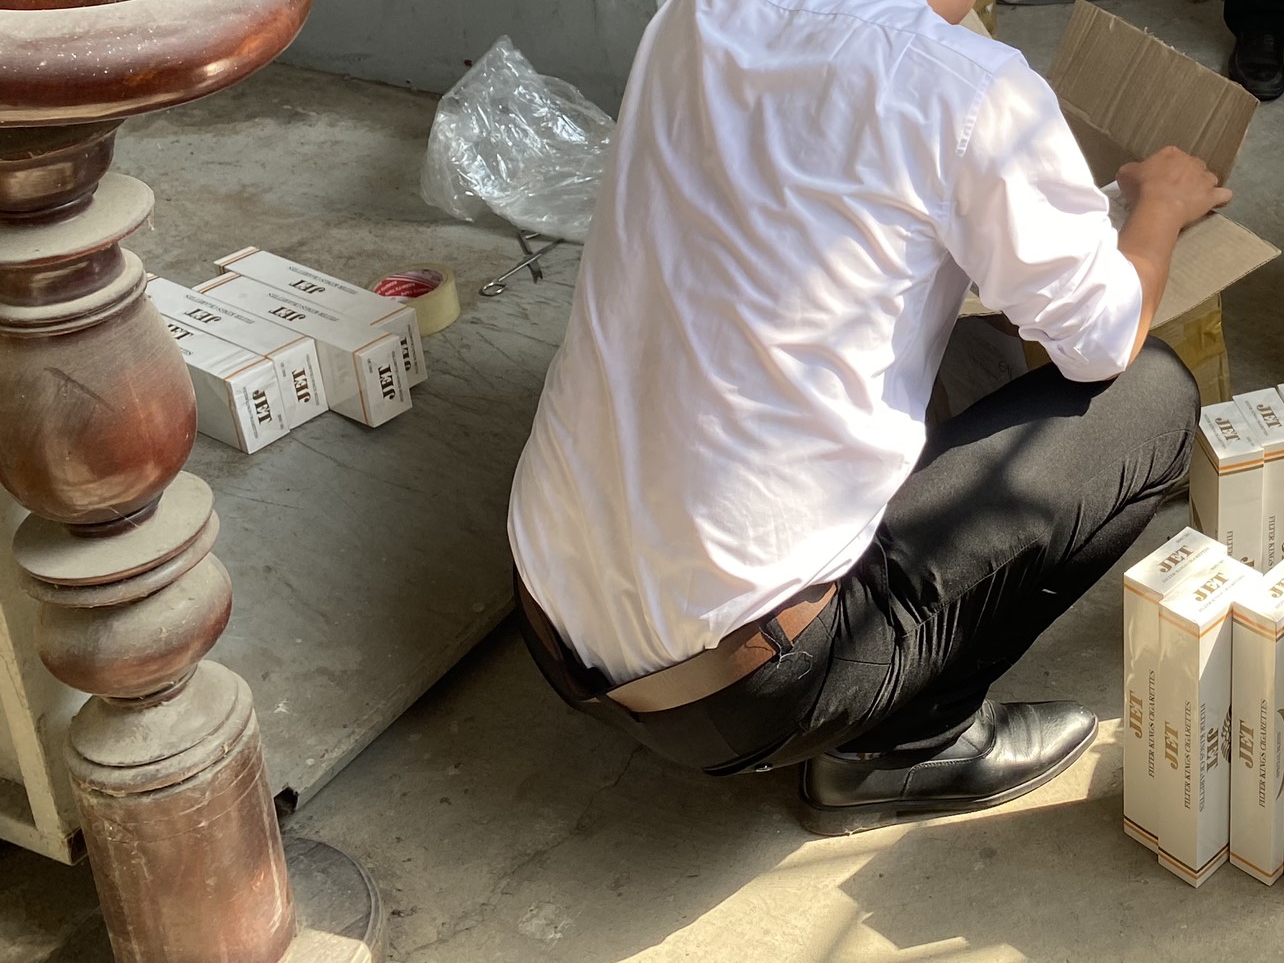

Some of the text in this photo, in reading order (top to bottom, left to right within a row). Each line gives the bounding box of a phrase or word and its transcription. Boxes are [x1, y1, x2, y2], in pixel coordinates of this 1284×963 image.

[289, 279, 326, 295] JET
[184, 308, 222, 324] JET
[269, 306, 306, 323] JET
[167, 323, 194, 341] ET
[291, 368, 311, 403] JET
[377, 364, 396, 400] JET
[252, 389, 273, 425] JET
[1256, 404, 1282, 429] JET
[1215, 417, 1241, 442] JET
[1157, 545, 1194, 574] JET
[1192, 572, 1230, 602] JET
[1130, 689, 1143, 739] JET
[1259, 699, 1267, 751] CIGARETTES
[1165, 721, 1179, 770] JET
[1207, 727, 1219, 773] JET
[1239, 719, 1254, 769] JET
